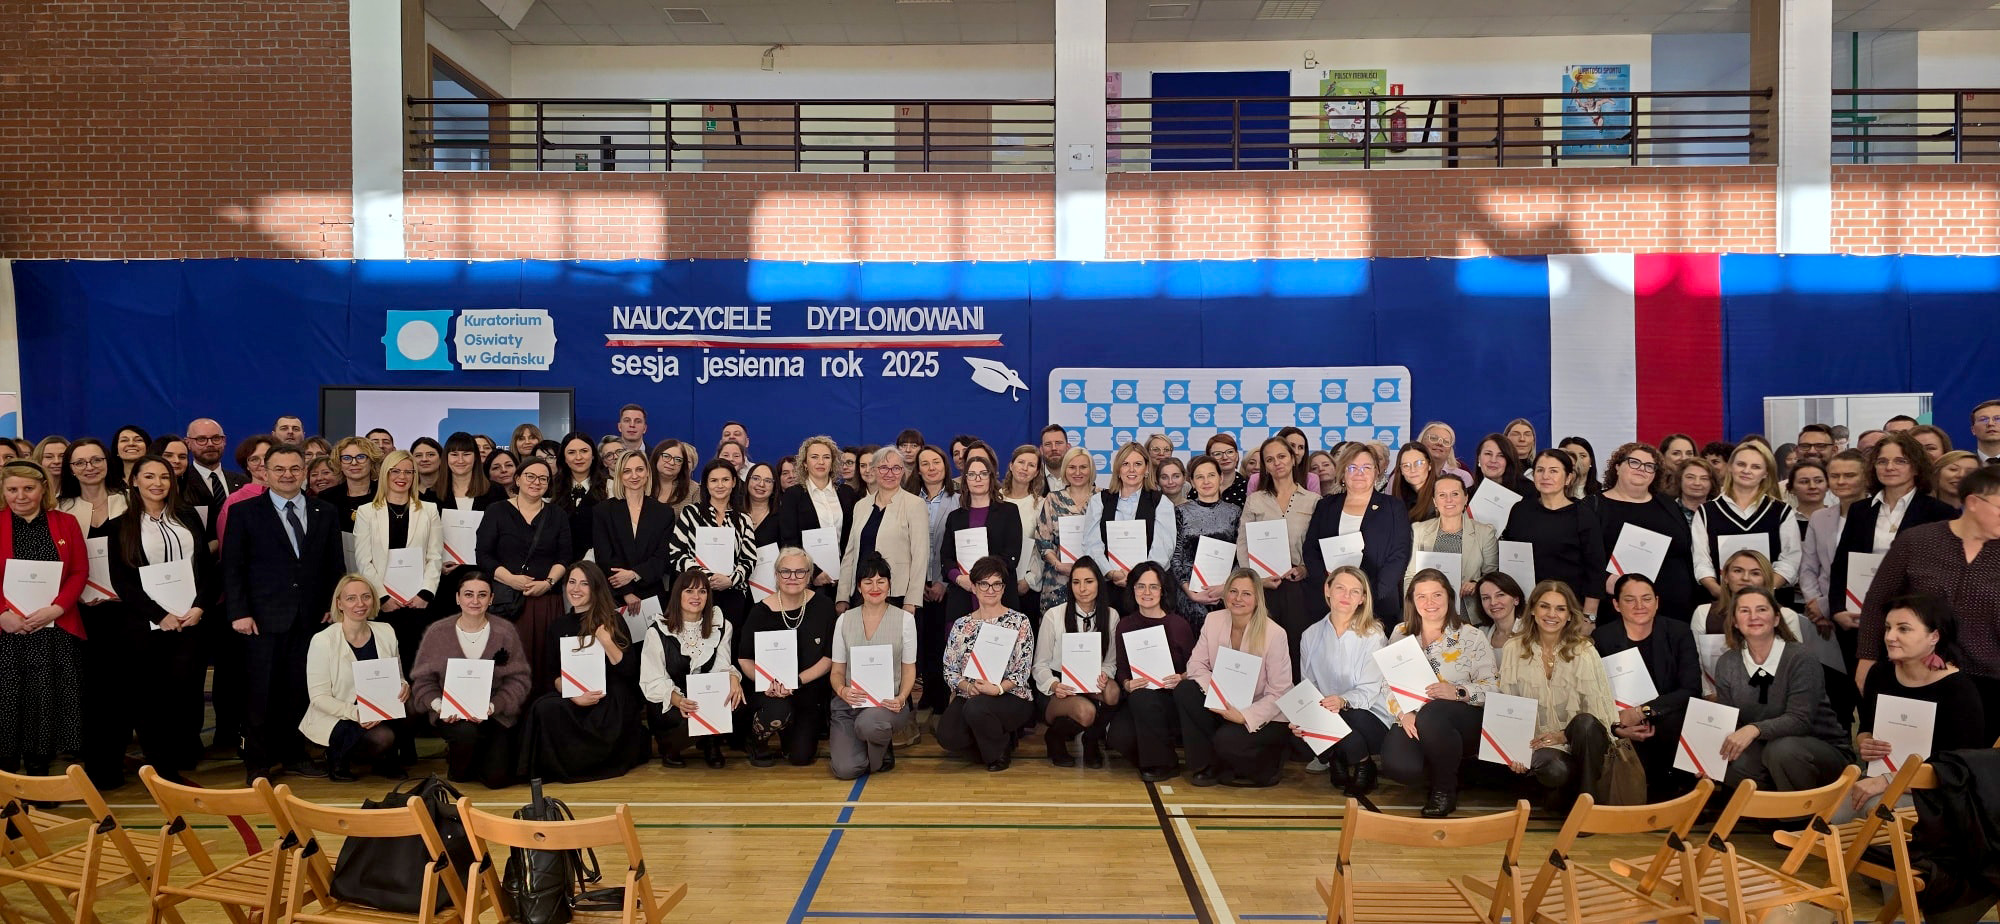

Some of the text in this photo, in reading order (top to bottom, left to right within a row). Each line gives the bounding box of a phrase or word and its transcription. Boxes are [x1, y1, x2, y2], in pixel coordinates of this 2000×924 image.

[902, 107, 910, 116] 17
[464, 313, 541, 327] Kuratorium
[612, 306, 985, 332] NAUCZYCIELE DYPLOMOWANI
[464, 333, 523, 349] Oświaty
[464, 351, 545, 365] w Gdańsku
[611, 347, 940, 385] sesja jesienna rok 2025
